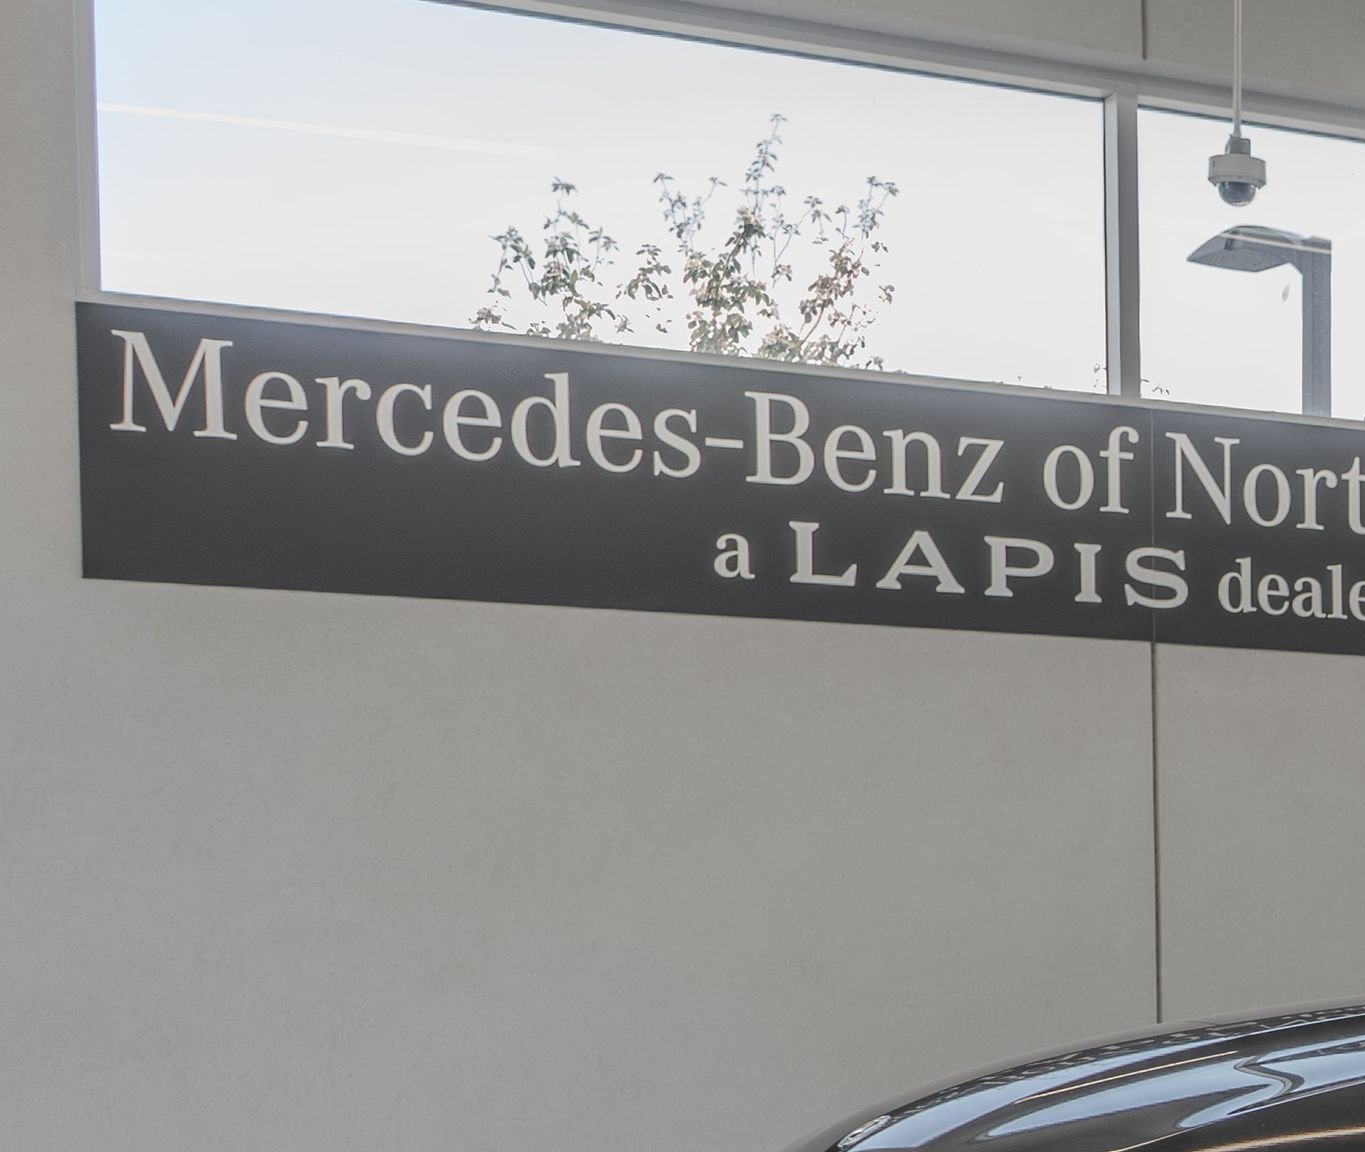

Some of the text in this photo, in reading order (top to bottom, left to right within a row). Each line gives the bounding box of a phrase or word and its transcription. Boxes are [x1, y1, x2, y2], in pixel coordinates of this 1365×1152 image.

[109, 329, 1005, 503] Mercedes-Benz
[1043, 425, 1140, 514] of
[713, 533, 756, 579] a
[788, 520, 1189, 609] LAPIS
